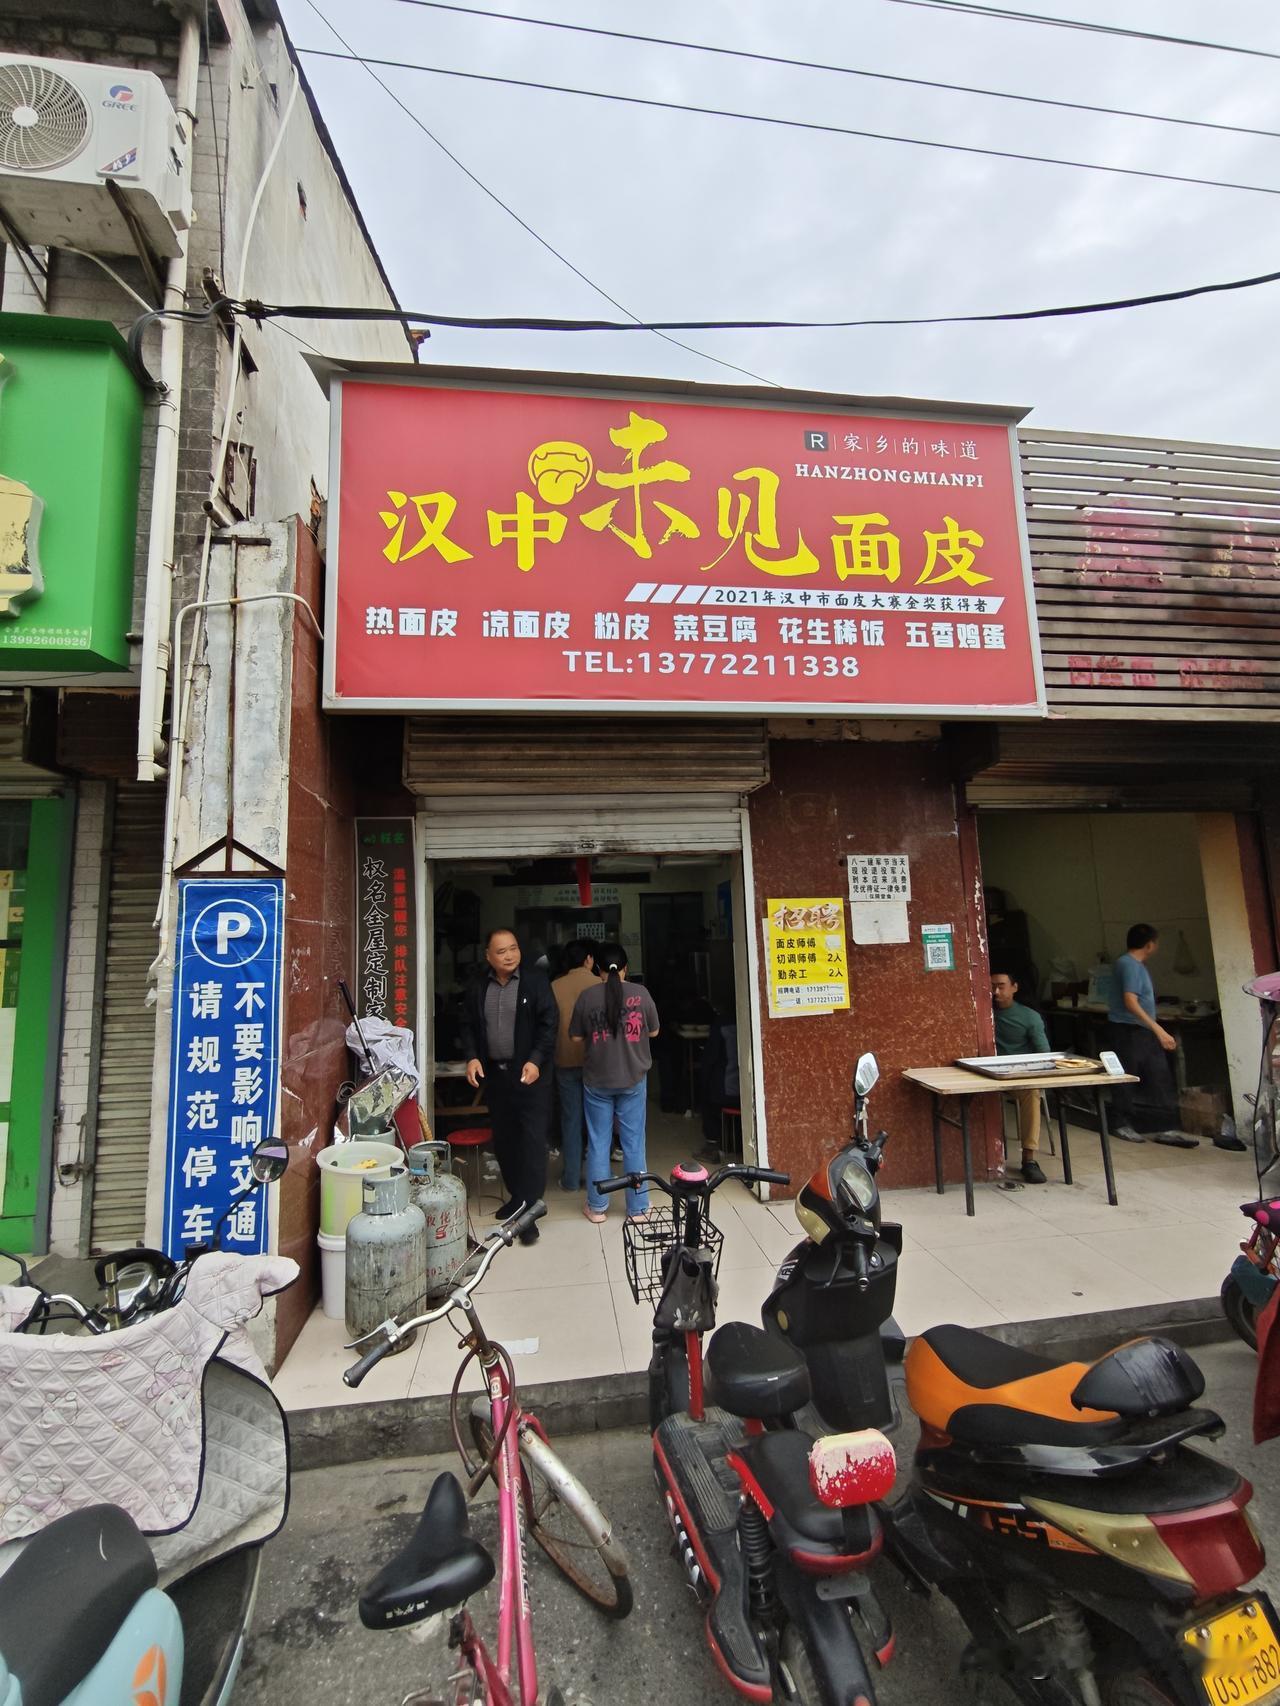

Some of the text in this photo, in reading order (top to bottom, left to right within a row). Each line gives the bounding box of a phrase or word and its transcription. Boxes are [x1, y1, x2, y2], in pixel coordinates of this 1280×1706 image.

[795, 463, 985, 488] HANZHONGMIANPI
[715, 588, 988, 613] 2021年汉中市面皮大赛金奖获得者
[366, 606, 1007, 650] 热面皮 凉面皮 粉皮 菜豆腐 花生稀饭 五香鸡蛋
[3, 635, 87, 647] 13992600926
[562, 650, 860, 677] TEL:13772211338
[216, 912, 251, 955] P
[775, 937, 816, 949] 面皮师傅
[827, 953, 842, 963] 2人
[828, 968, 843, 978] 2人
[181, 980, 223, 1242] 请规范停车
[226, 981, 266, 1241] 不要影响交通
